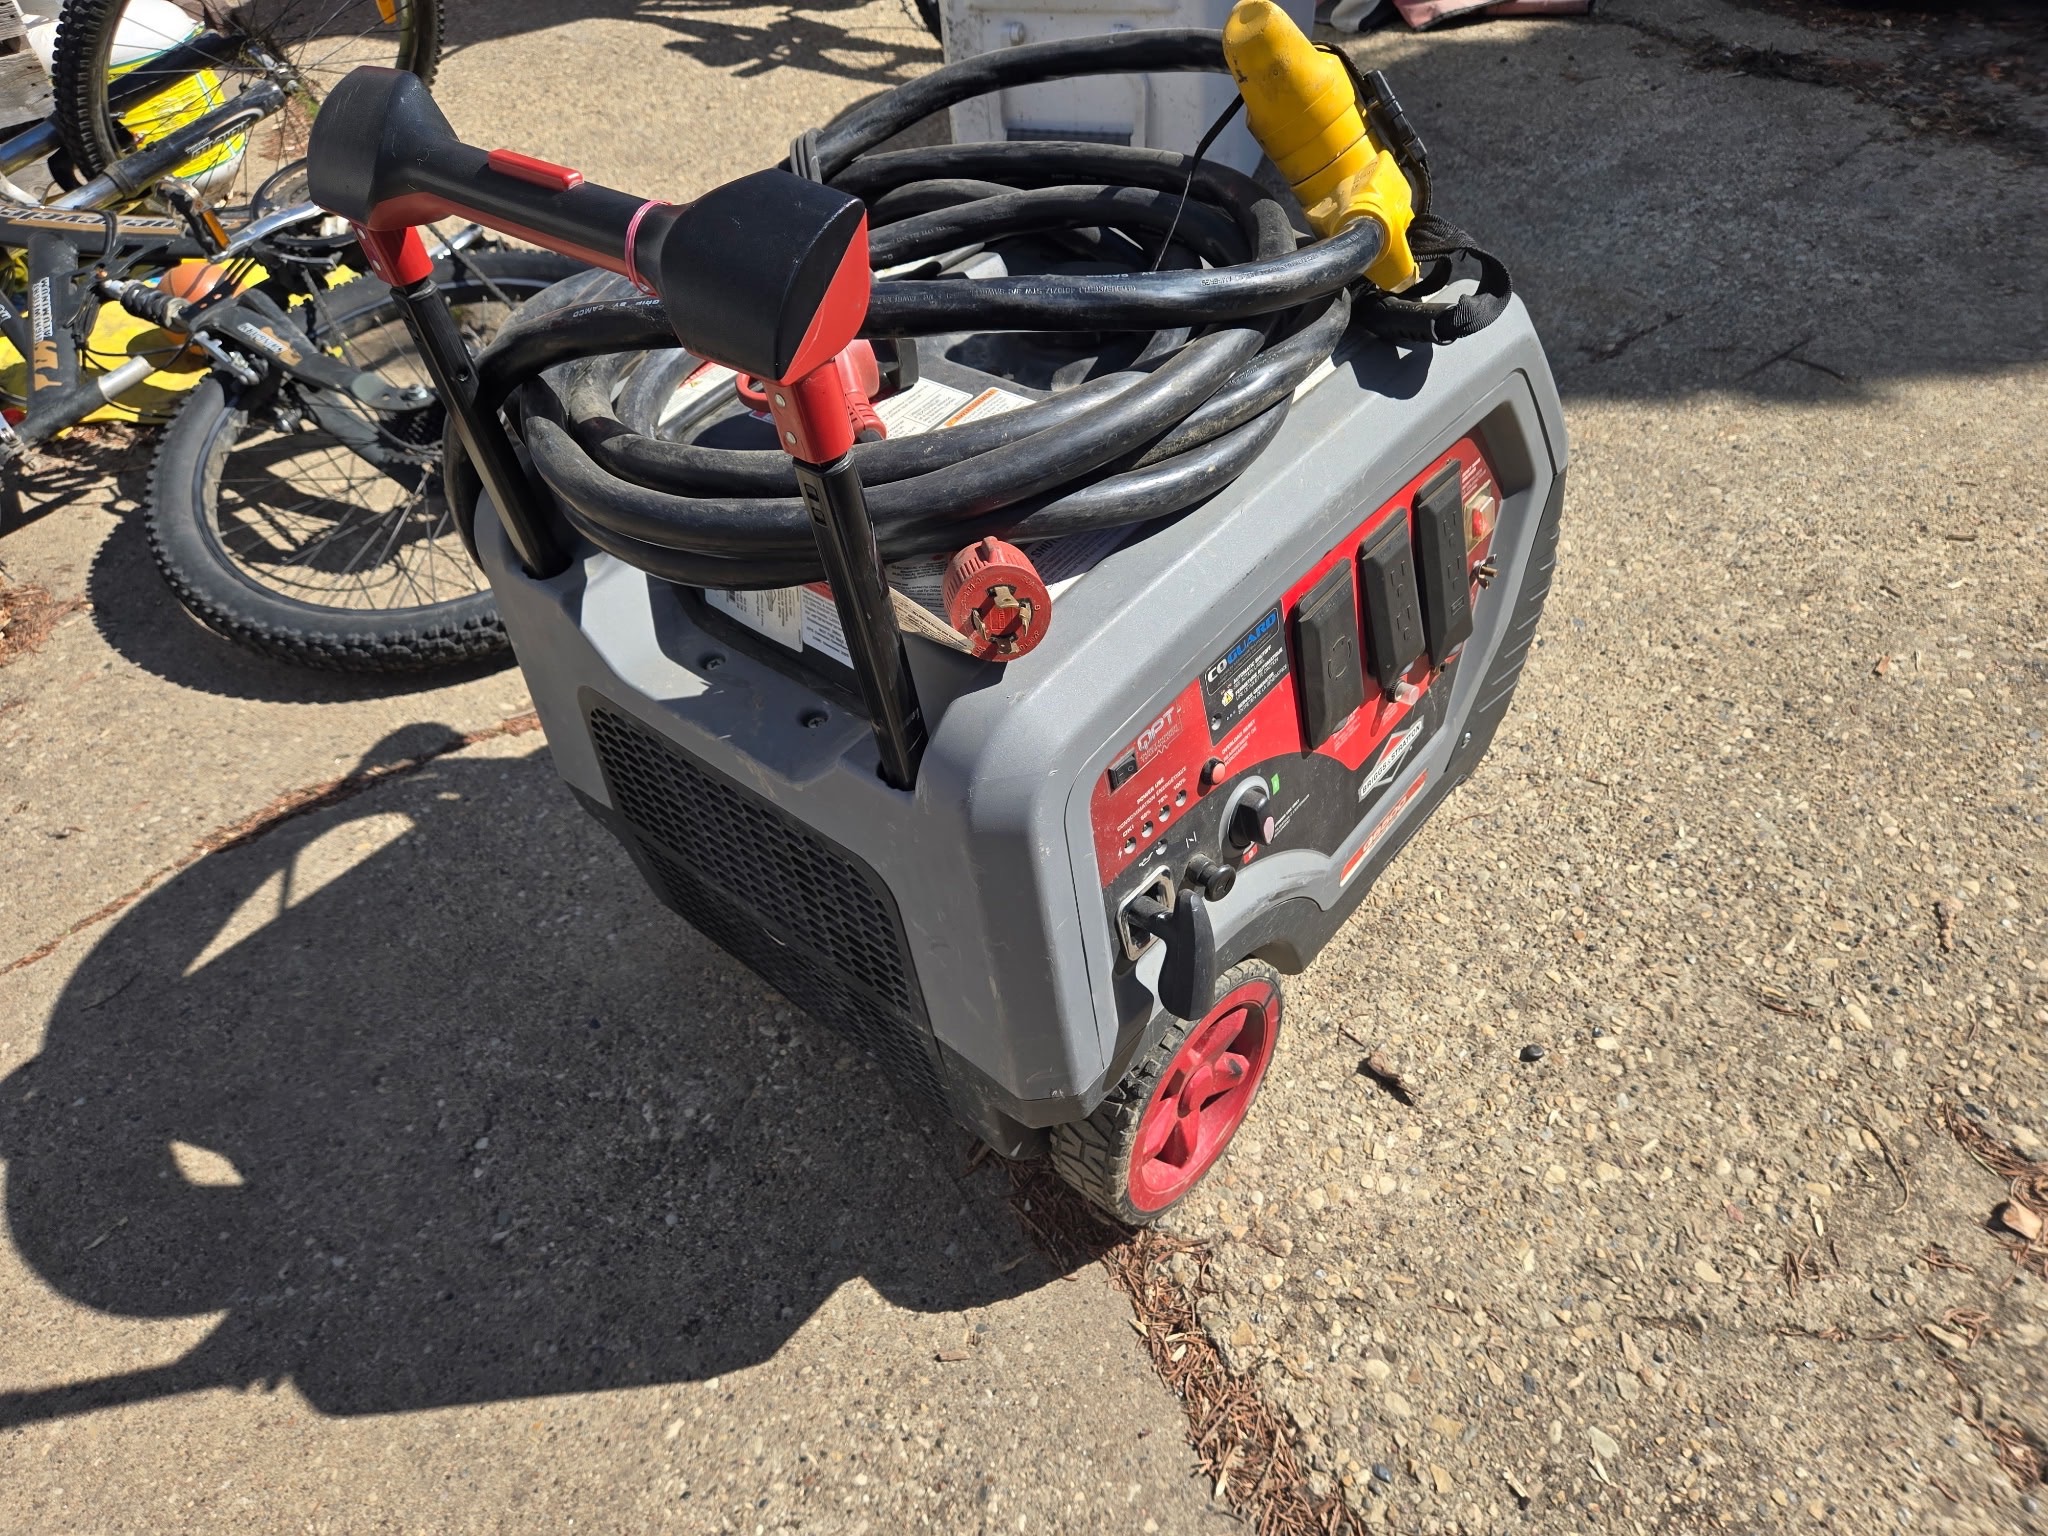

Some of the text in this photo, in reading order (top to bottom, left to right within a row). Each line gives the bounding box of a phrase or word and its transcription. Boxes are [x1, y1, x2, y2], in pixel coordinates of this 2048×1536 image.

[41, 277, 52, 336] ALUMINUM
[572, 304, 605, 318] CAMCO
[1207, 611, 1277, 683] COGUARD
[1233, 660, 1254, 684] AUTOMATIC
[1137, 706, 1174, 751] QPT
[1361, 761, 1387, 794] BRIGGS
[1391, 724, 1421, 761] STRATTON
[1136, 777, 1165, 804] POWER USE
[1173, 778, 1186, 790] 100%
